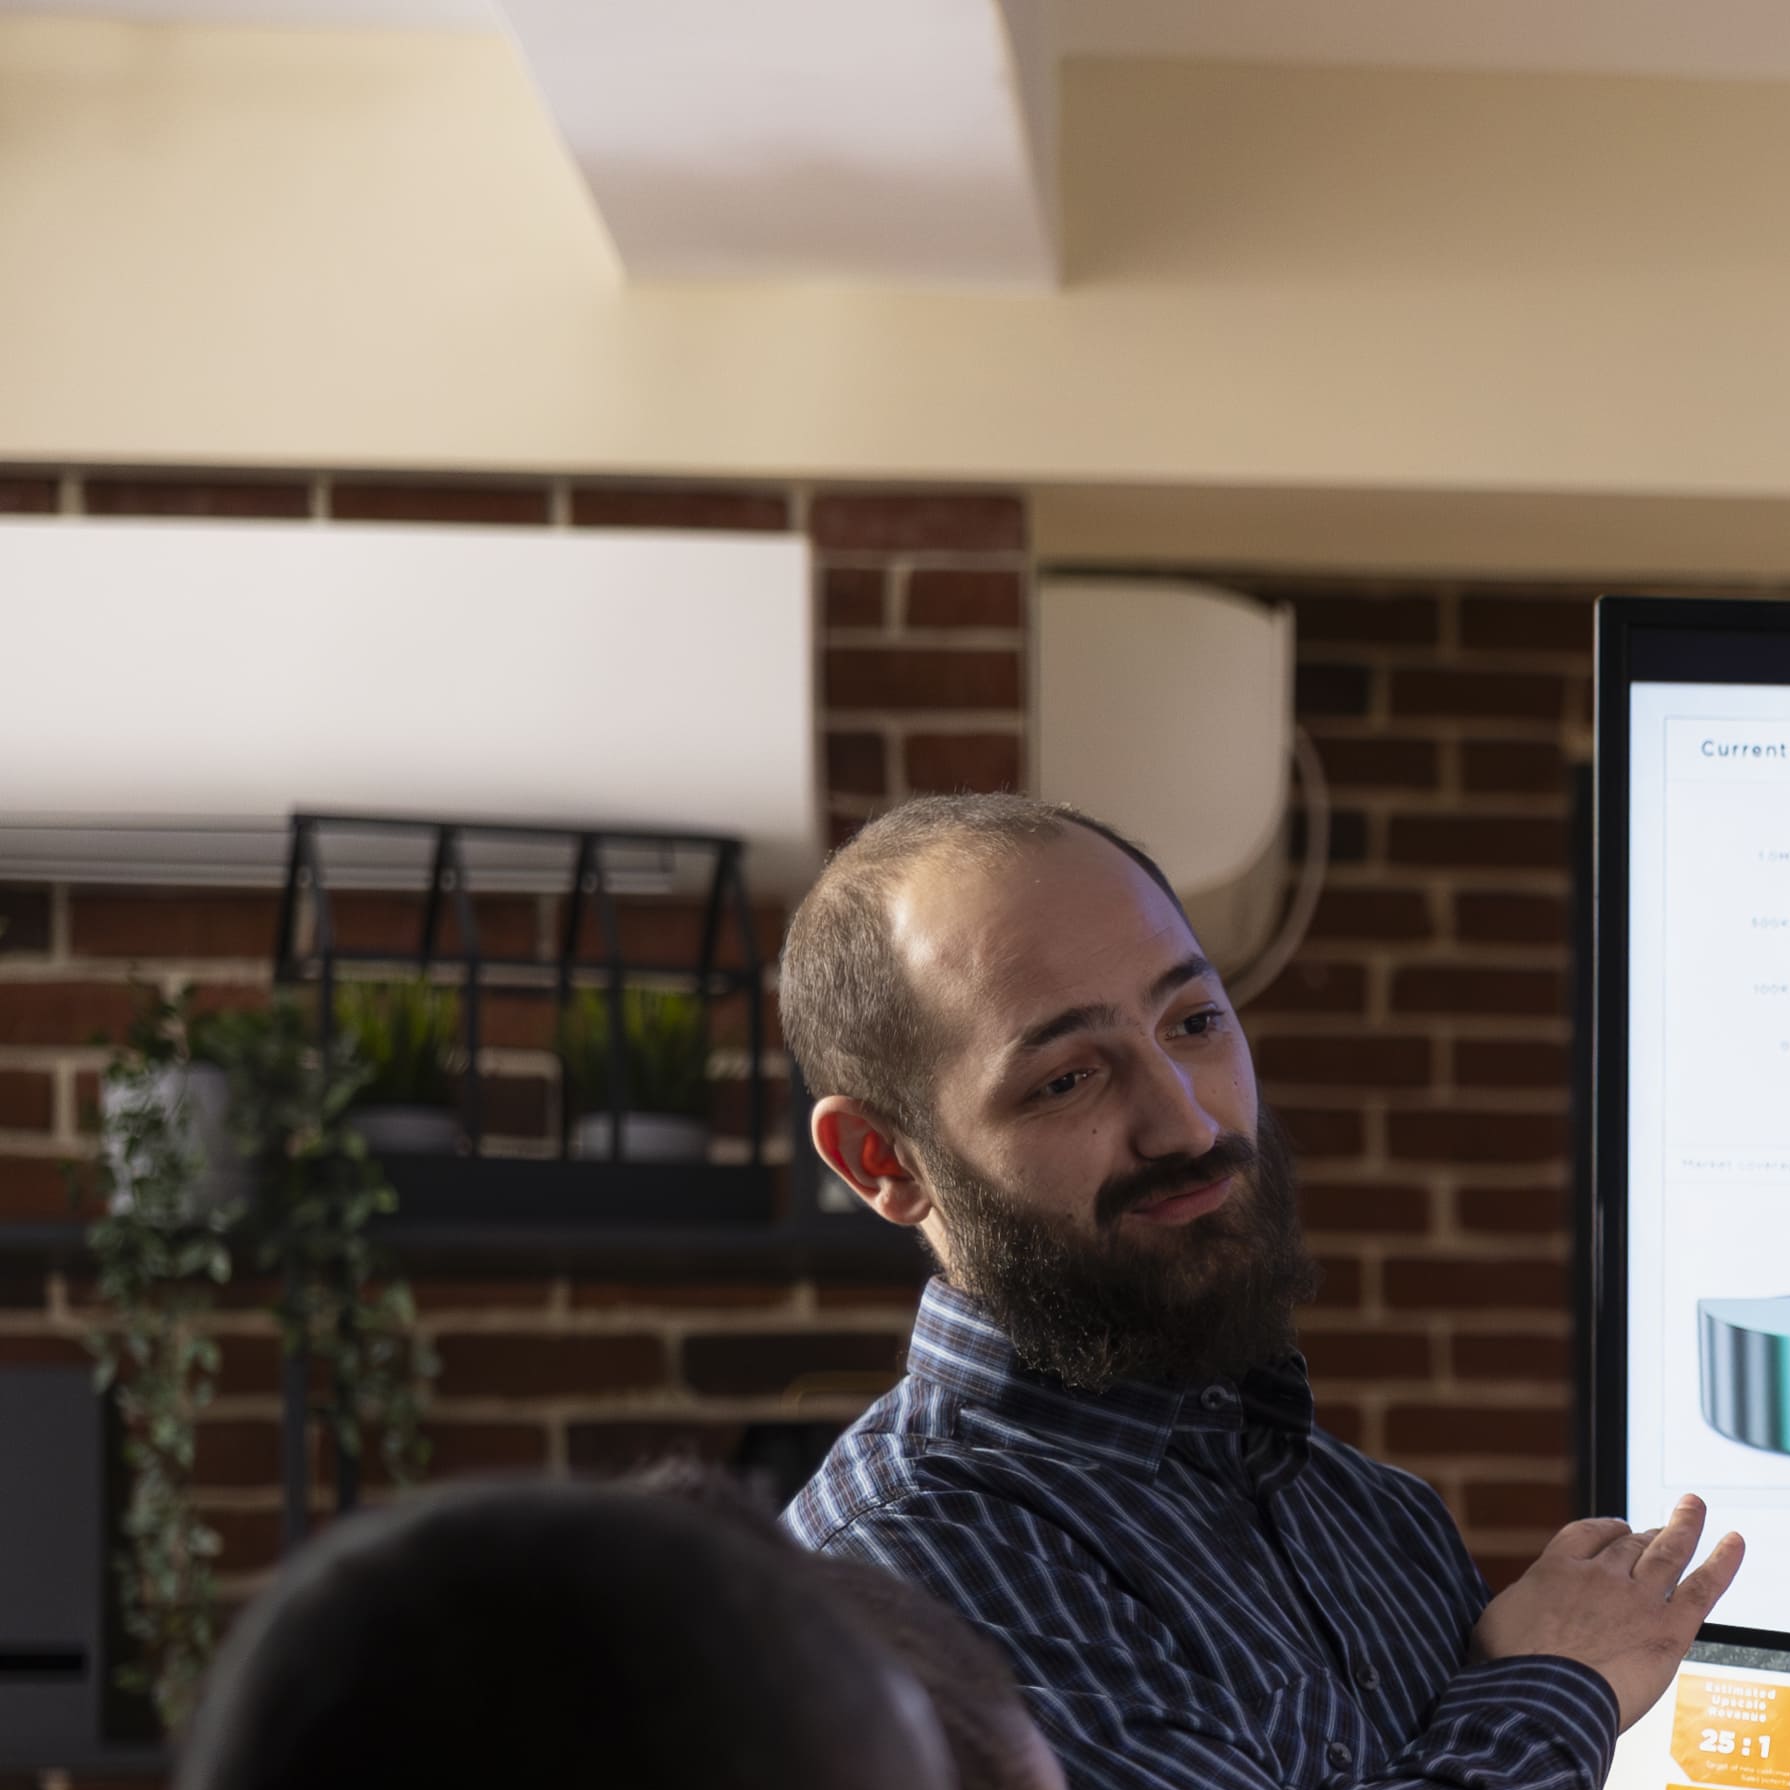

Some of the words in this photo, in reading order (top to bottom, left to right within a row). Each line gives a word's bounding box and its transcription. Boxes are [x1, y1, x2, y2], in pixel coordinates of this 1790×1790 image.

[1700, 740, 1786, 758] Current
[1705, 1681, 1776, 1700] Estimated
[1711, 1695, 1767, 1711] Upscale
[1707, 1707, 1767, 1723] Revenue
[1699, 1728, 1736, 1754] 25
[1758, 1735, 1771, 1759] 1
